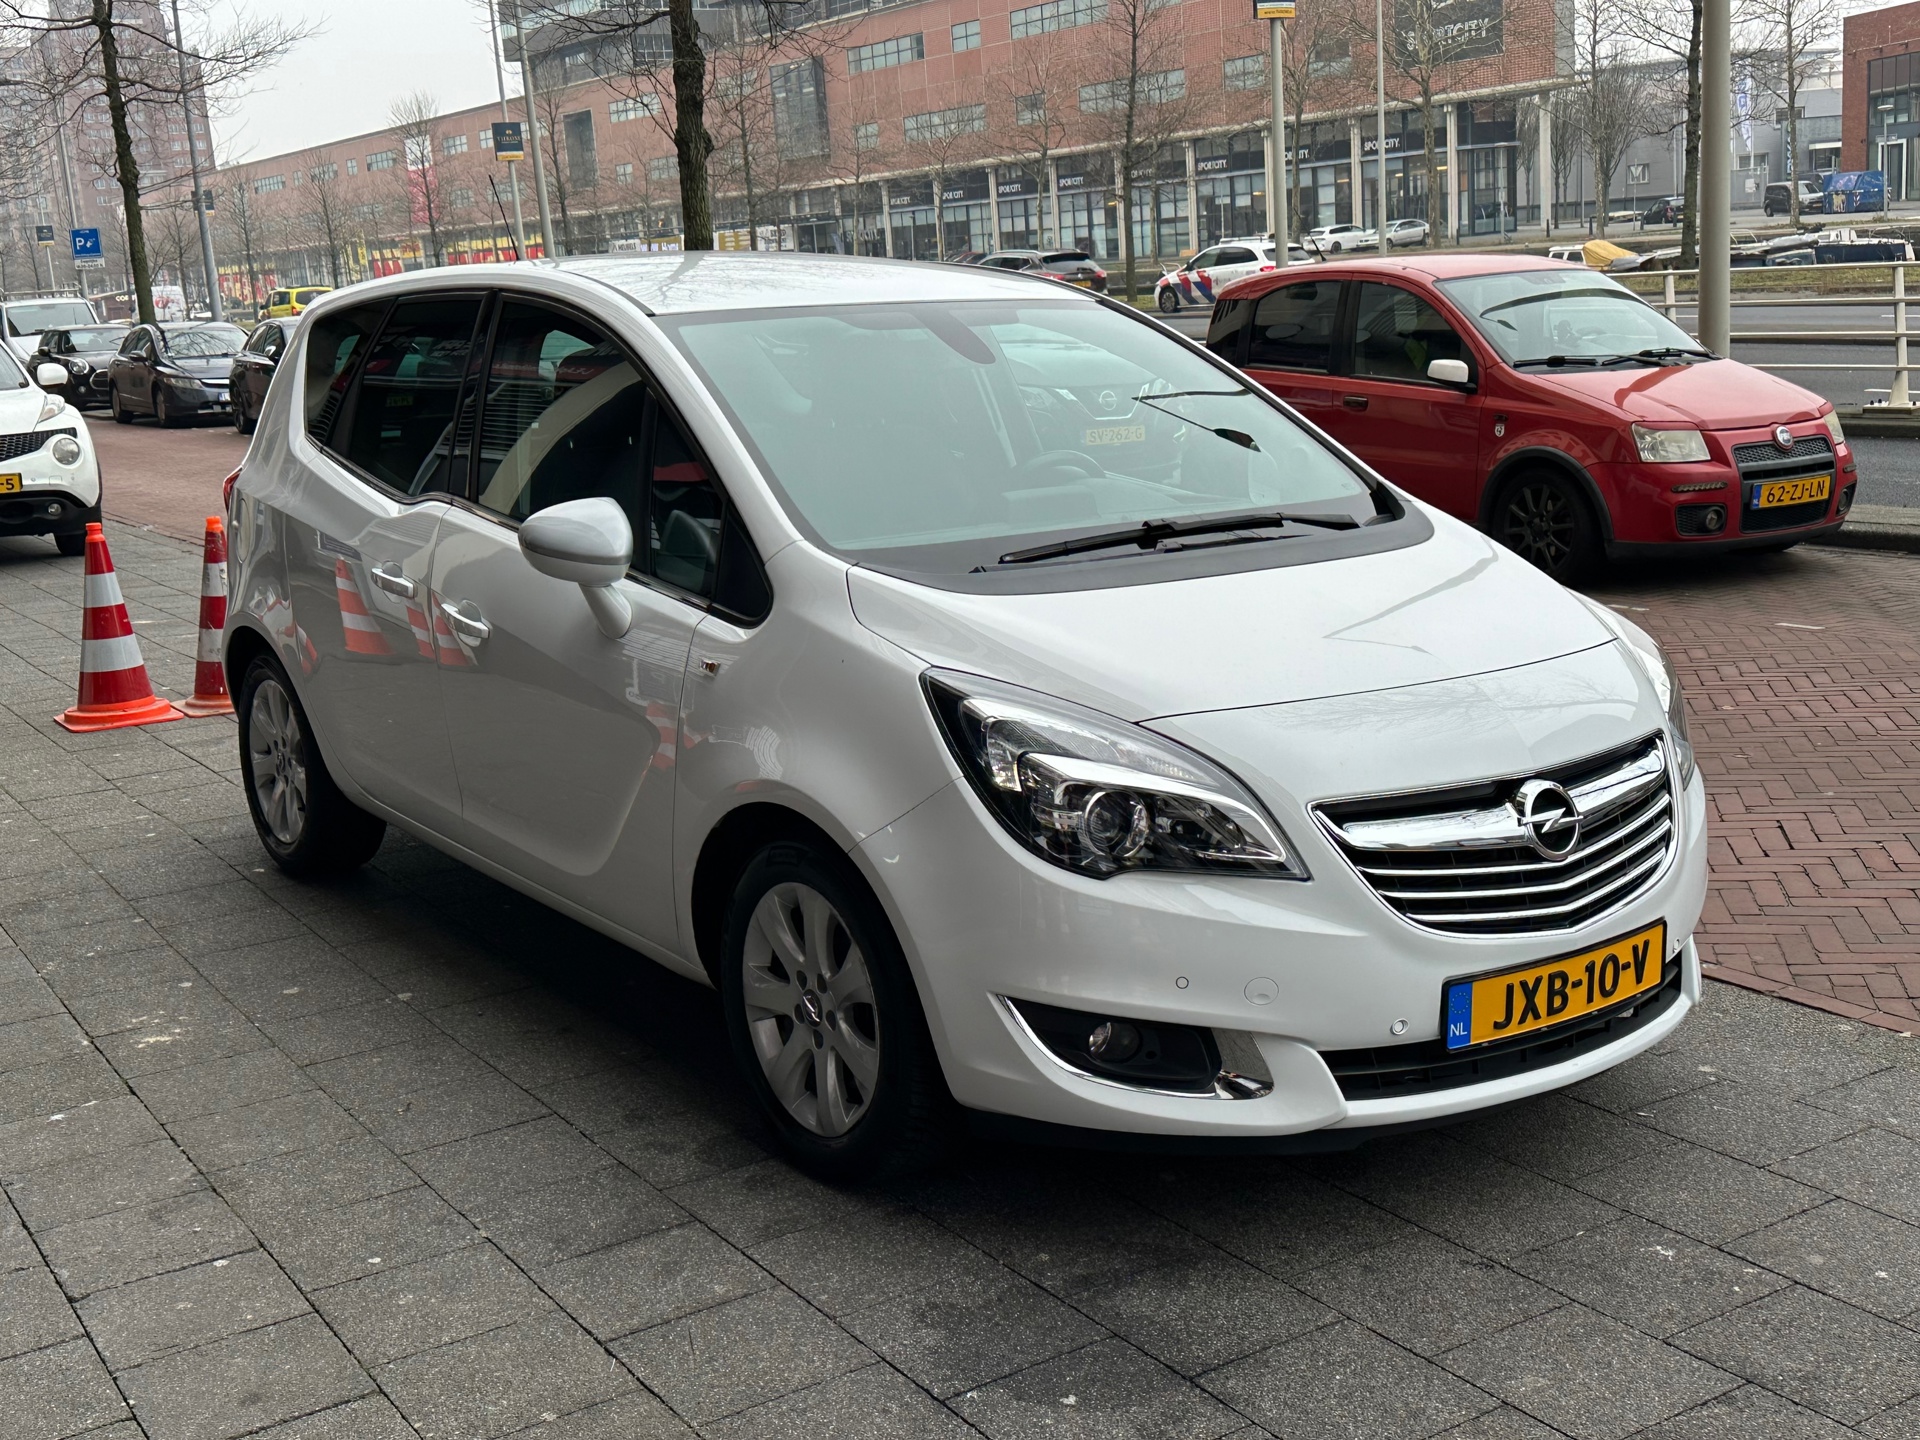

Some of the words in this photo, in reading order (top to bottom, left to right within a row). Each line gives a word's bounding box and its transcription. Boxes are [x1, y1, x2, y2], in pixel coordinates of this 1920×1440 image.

[1406, 18, 1489, 50] SRTCITY
[1364, 137, 1400, 151] SPOCITY
[1089, 427, 1143, 444] SV-262-G
[1766, 480, 1825, 504] 62-ZJ-LN
[1493, 939, 1650, 1031] JXB-10-V
[1450, 1022, 1468, 1037] NL
